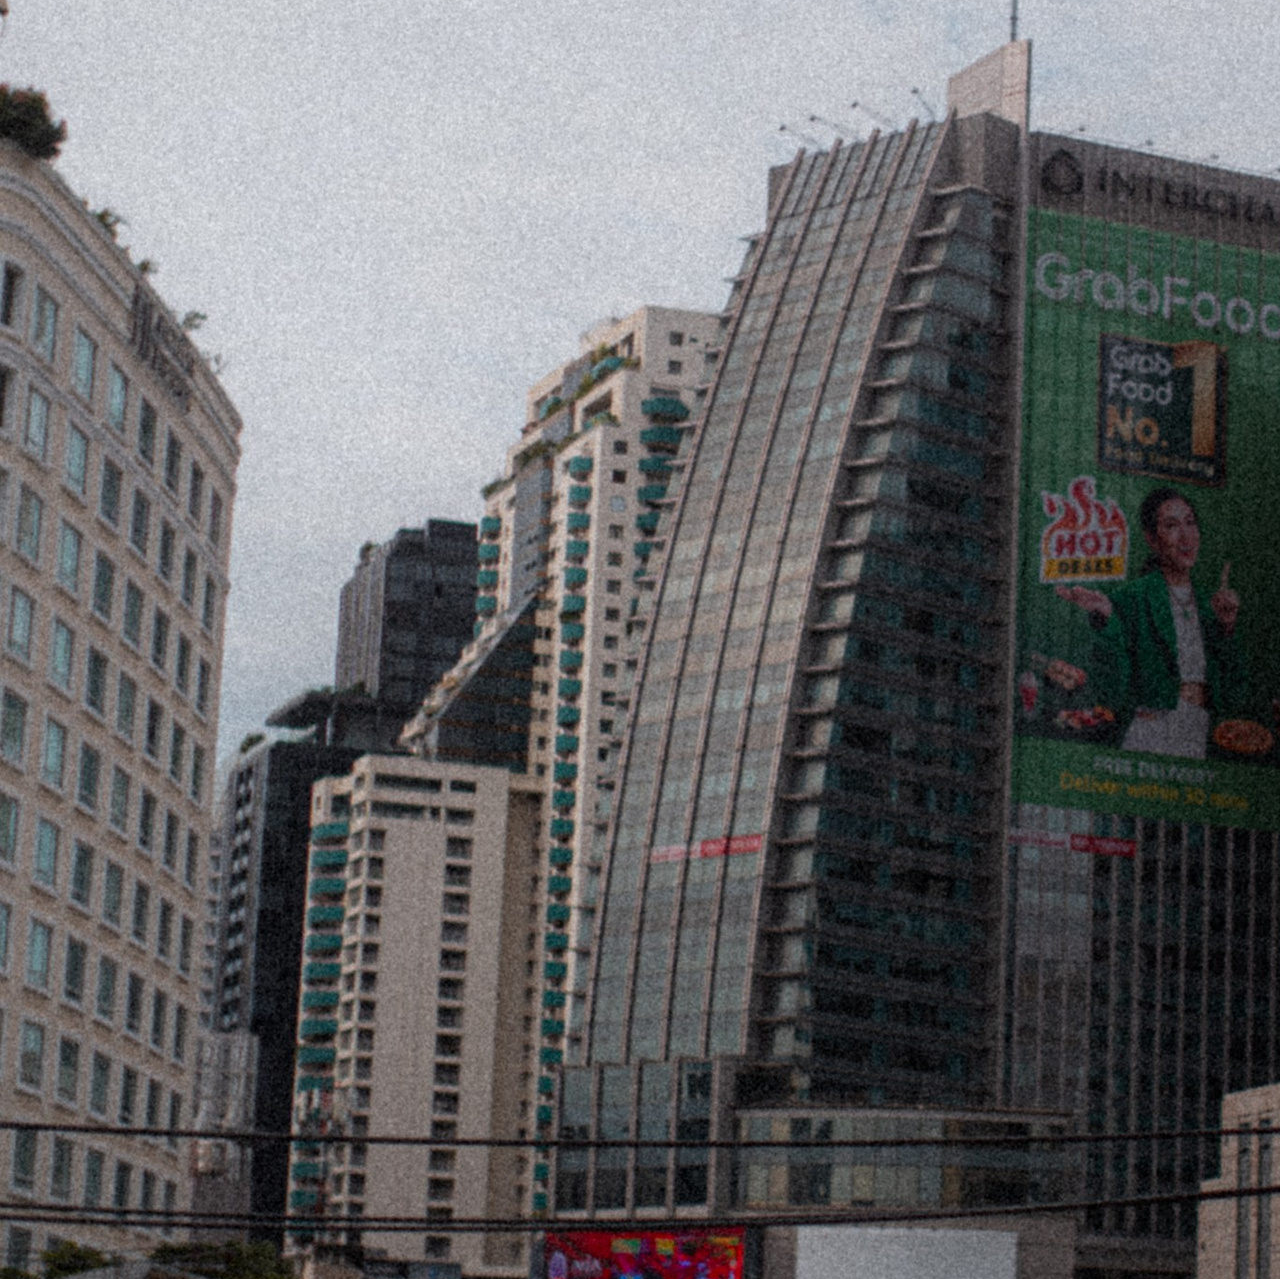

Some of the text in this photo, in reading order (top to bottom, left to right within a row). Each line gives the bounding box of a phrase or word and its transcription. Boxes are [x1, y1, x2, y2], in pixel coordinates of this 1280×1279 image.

[1109, 344, 1173, 375] Grab
[1106, 373, 1173, 406] Food
[1105, 404, 1169, 448] No.
[1054, 530, 1121, 557] HOT
